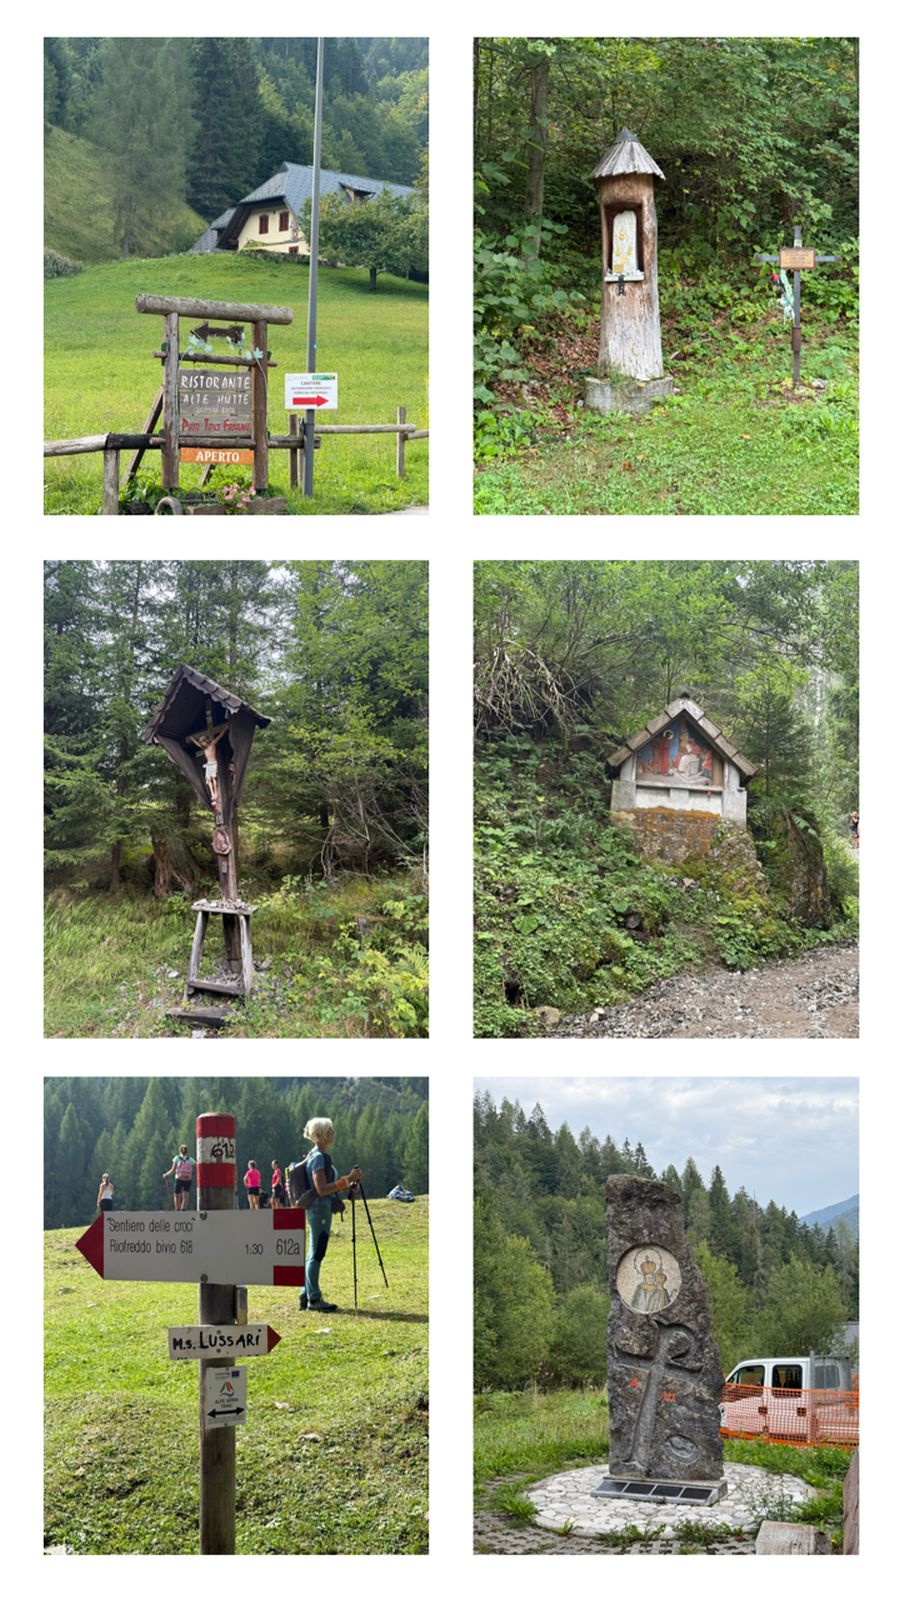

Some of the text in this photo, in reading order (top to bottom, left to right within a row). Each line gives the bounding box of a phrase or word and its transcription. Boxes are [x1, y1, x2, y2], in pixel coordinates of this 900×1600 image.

[181, 375, 251, 390] RISTORANTE
[183, 393, 208, 405] ALTE
[196, 450, 240, 463] APERTO
[211, 1142, 235, 1159] 612
[149, 1218, 170, 1233] delle
[109, 1238, 193, 1254] Riofreddo bivio 618
[245, 1243, 263, 1255] 1:30
[276, 1238, 300, 1256] 612a
